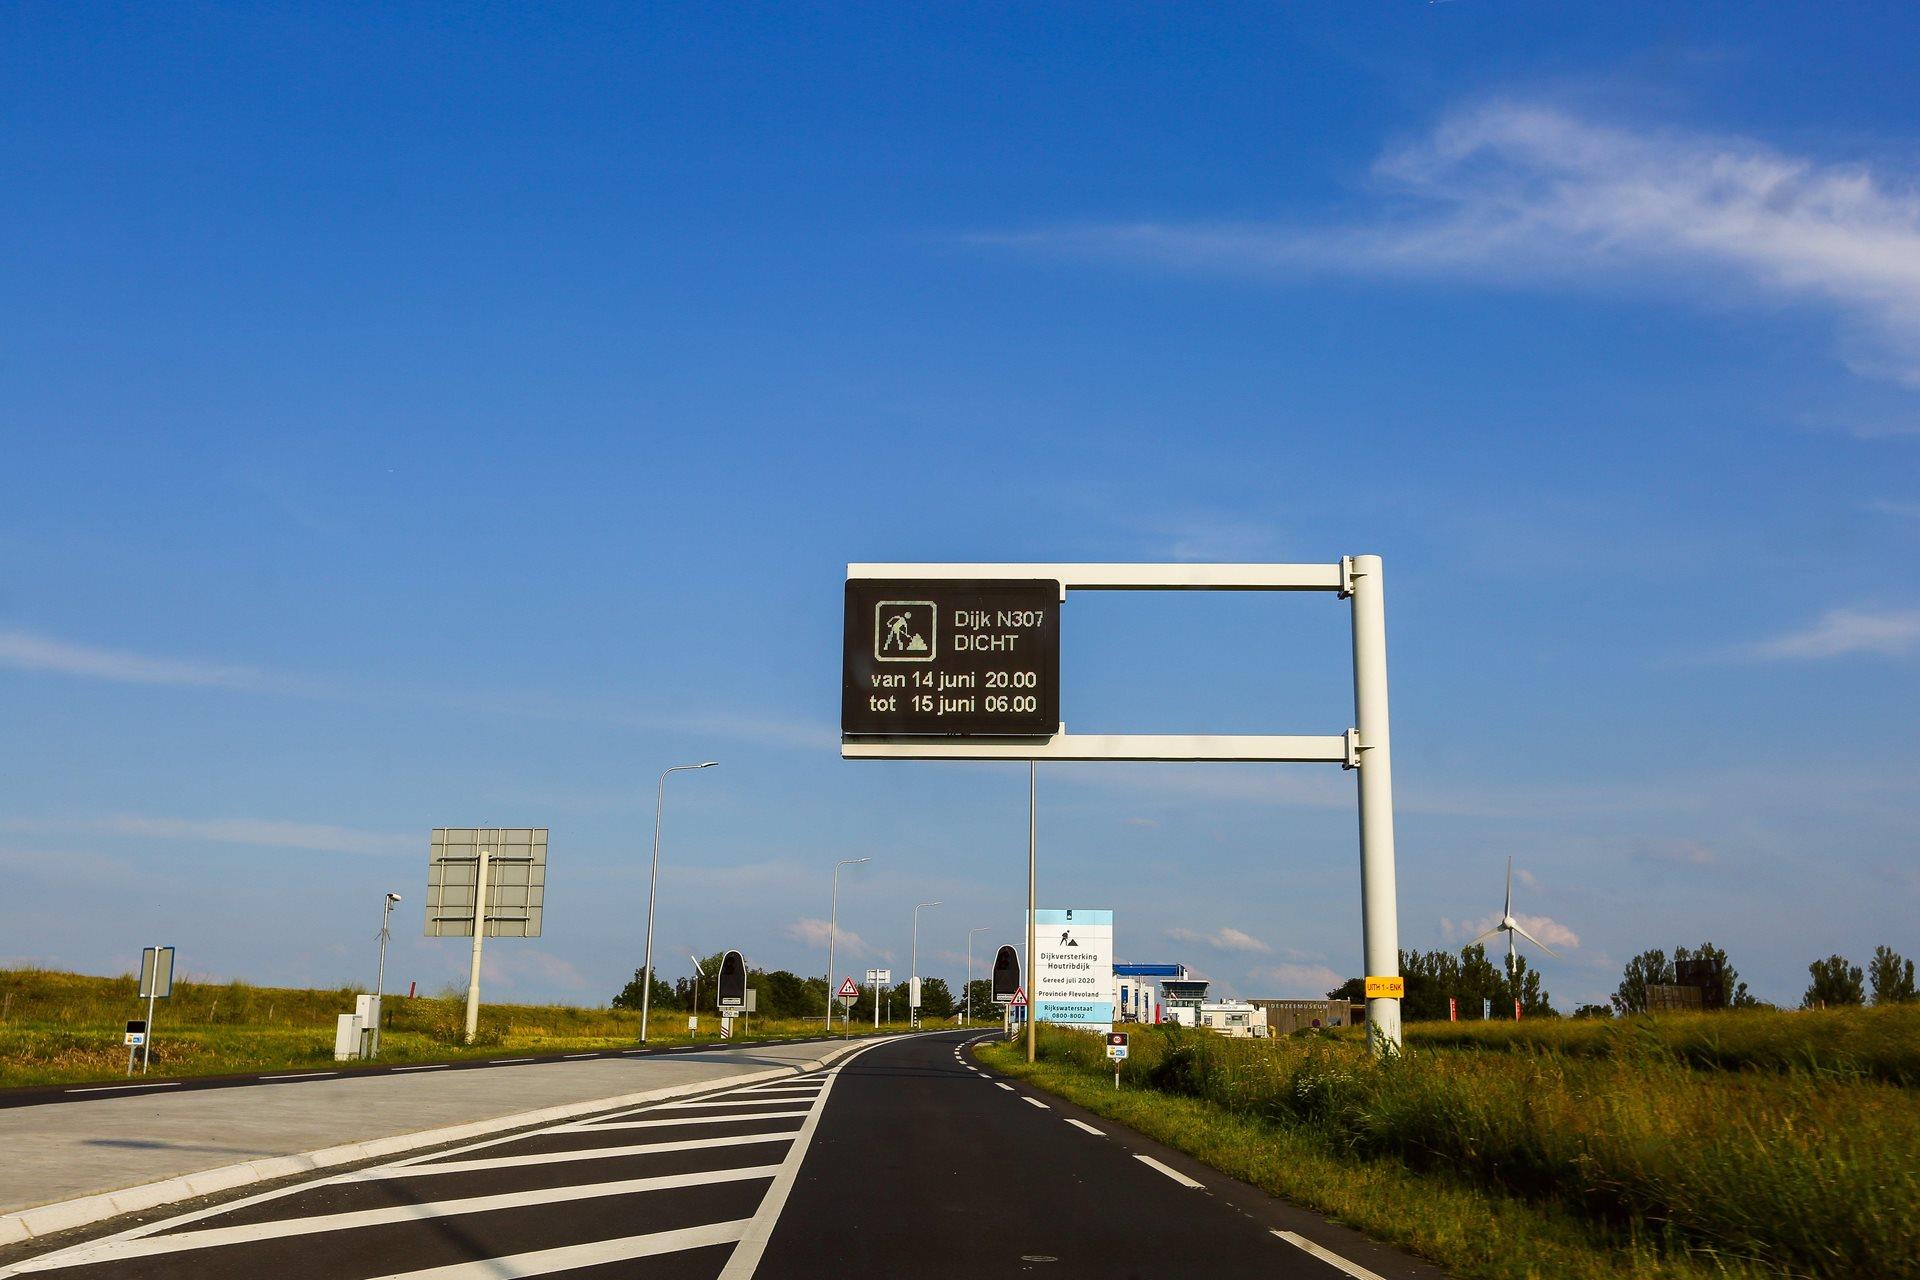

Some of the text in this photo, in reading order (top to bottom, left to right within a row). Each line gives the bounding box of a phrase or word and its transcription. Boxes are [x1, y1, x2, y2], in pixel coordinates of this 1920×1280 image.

[954, 610, 1044, 630] Dijk N307
[954, 634, 1019, 651] DICHT
[871, 671, 1037, 692] van 14 juni 20.00
[869, 695, 1037, 716] tot 15 juni 06.00
[1040, 952, 1098, 961] Dijkversterking
[1066, 977, 1077, 985] juli
[1038, 990, 1099, 998] Provincie Flevoland
[1044, 1004, 1093, 1012] Rijkswaterstaat
